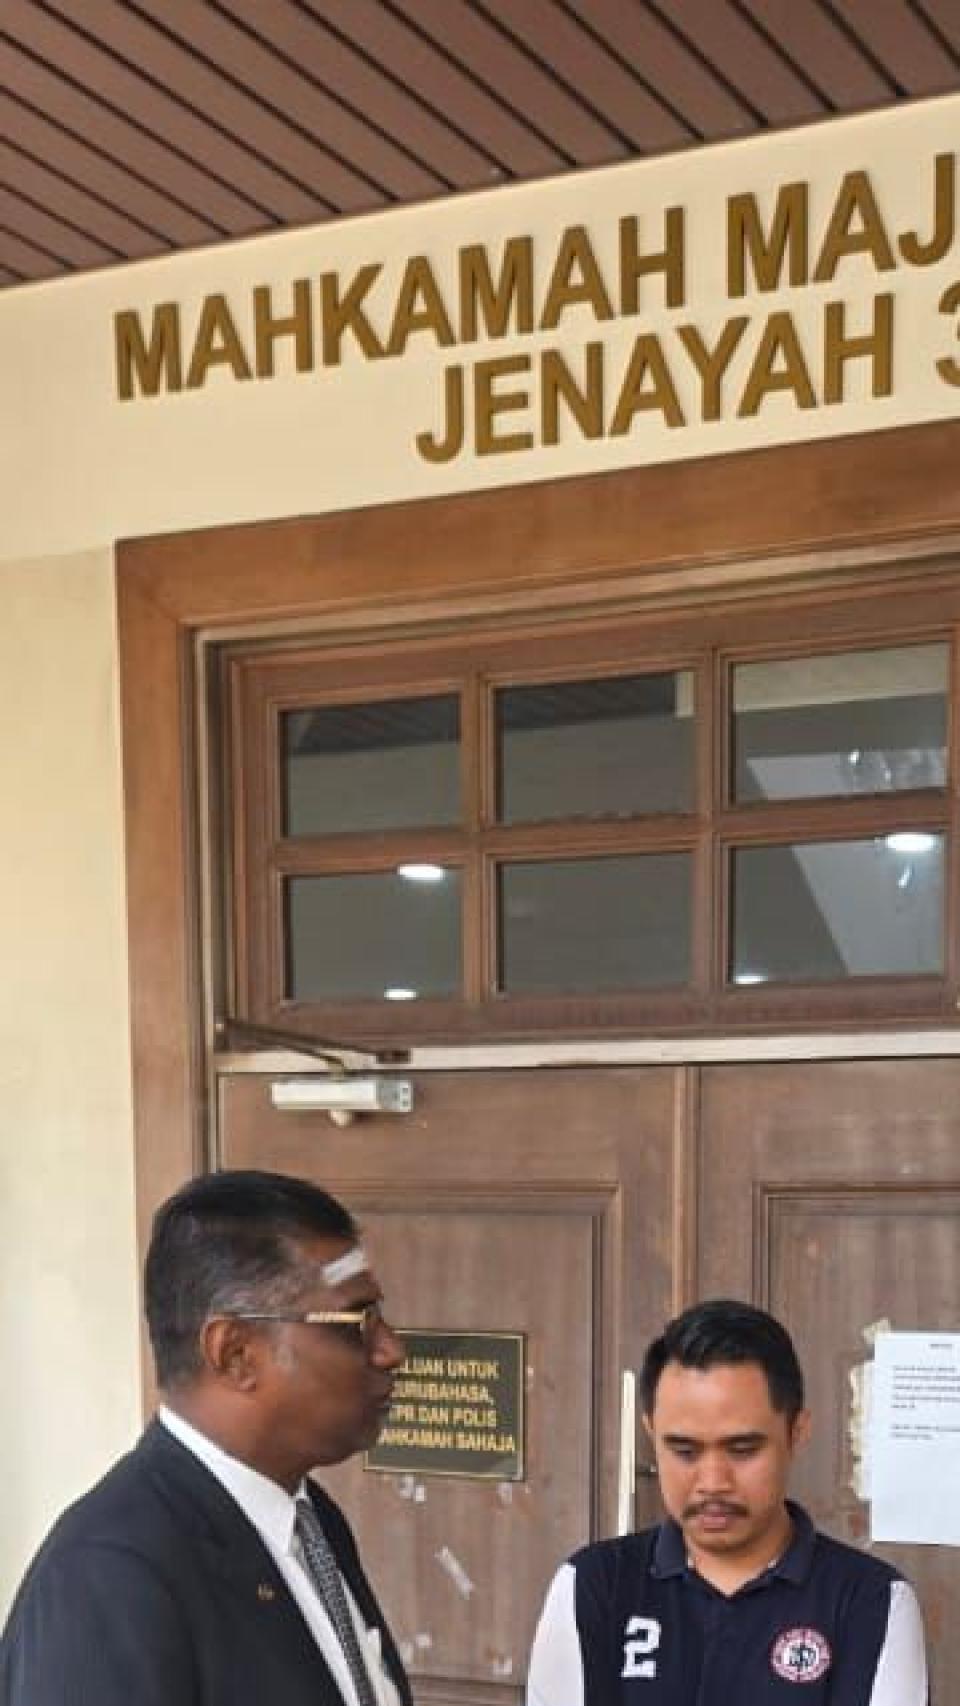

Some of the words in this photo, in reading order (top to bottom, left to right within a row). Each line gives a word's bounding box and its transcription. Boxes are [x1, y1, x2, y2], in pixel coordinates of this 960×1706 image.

[115, 208, 685, 401] MAHKAMAH
[416, 294, 894, 463] JENAYAH
[392, 1357, 443, 1376] LUAN
[447, 1359, 499, 1379] UNTUK
[418, 1406, 449, 1426] DAN
[452, 1408, 498, 1428] POLIS
[376, 1427, 452, 1448] AHKAMAH
[455, 1431, 516, 1452] SAHAJA
[621, 1615, 663, 1679] 2
